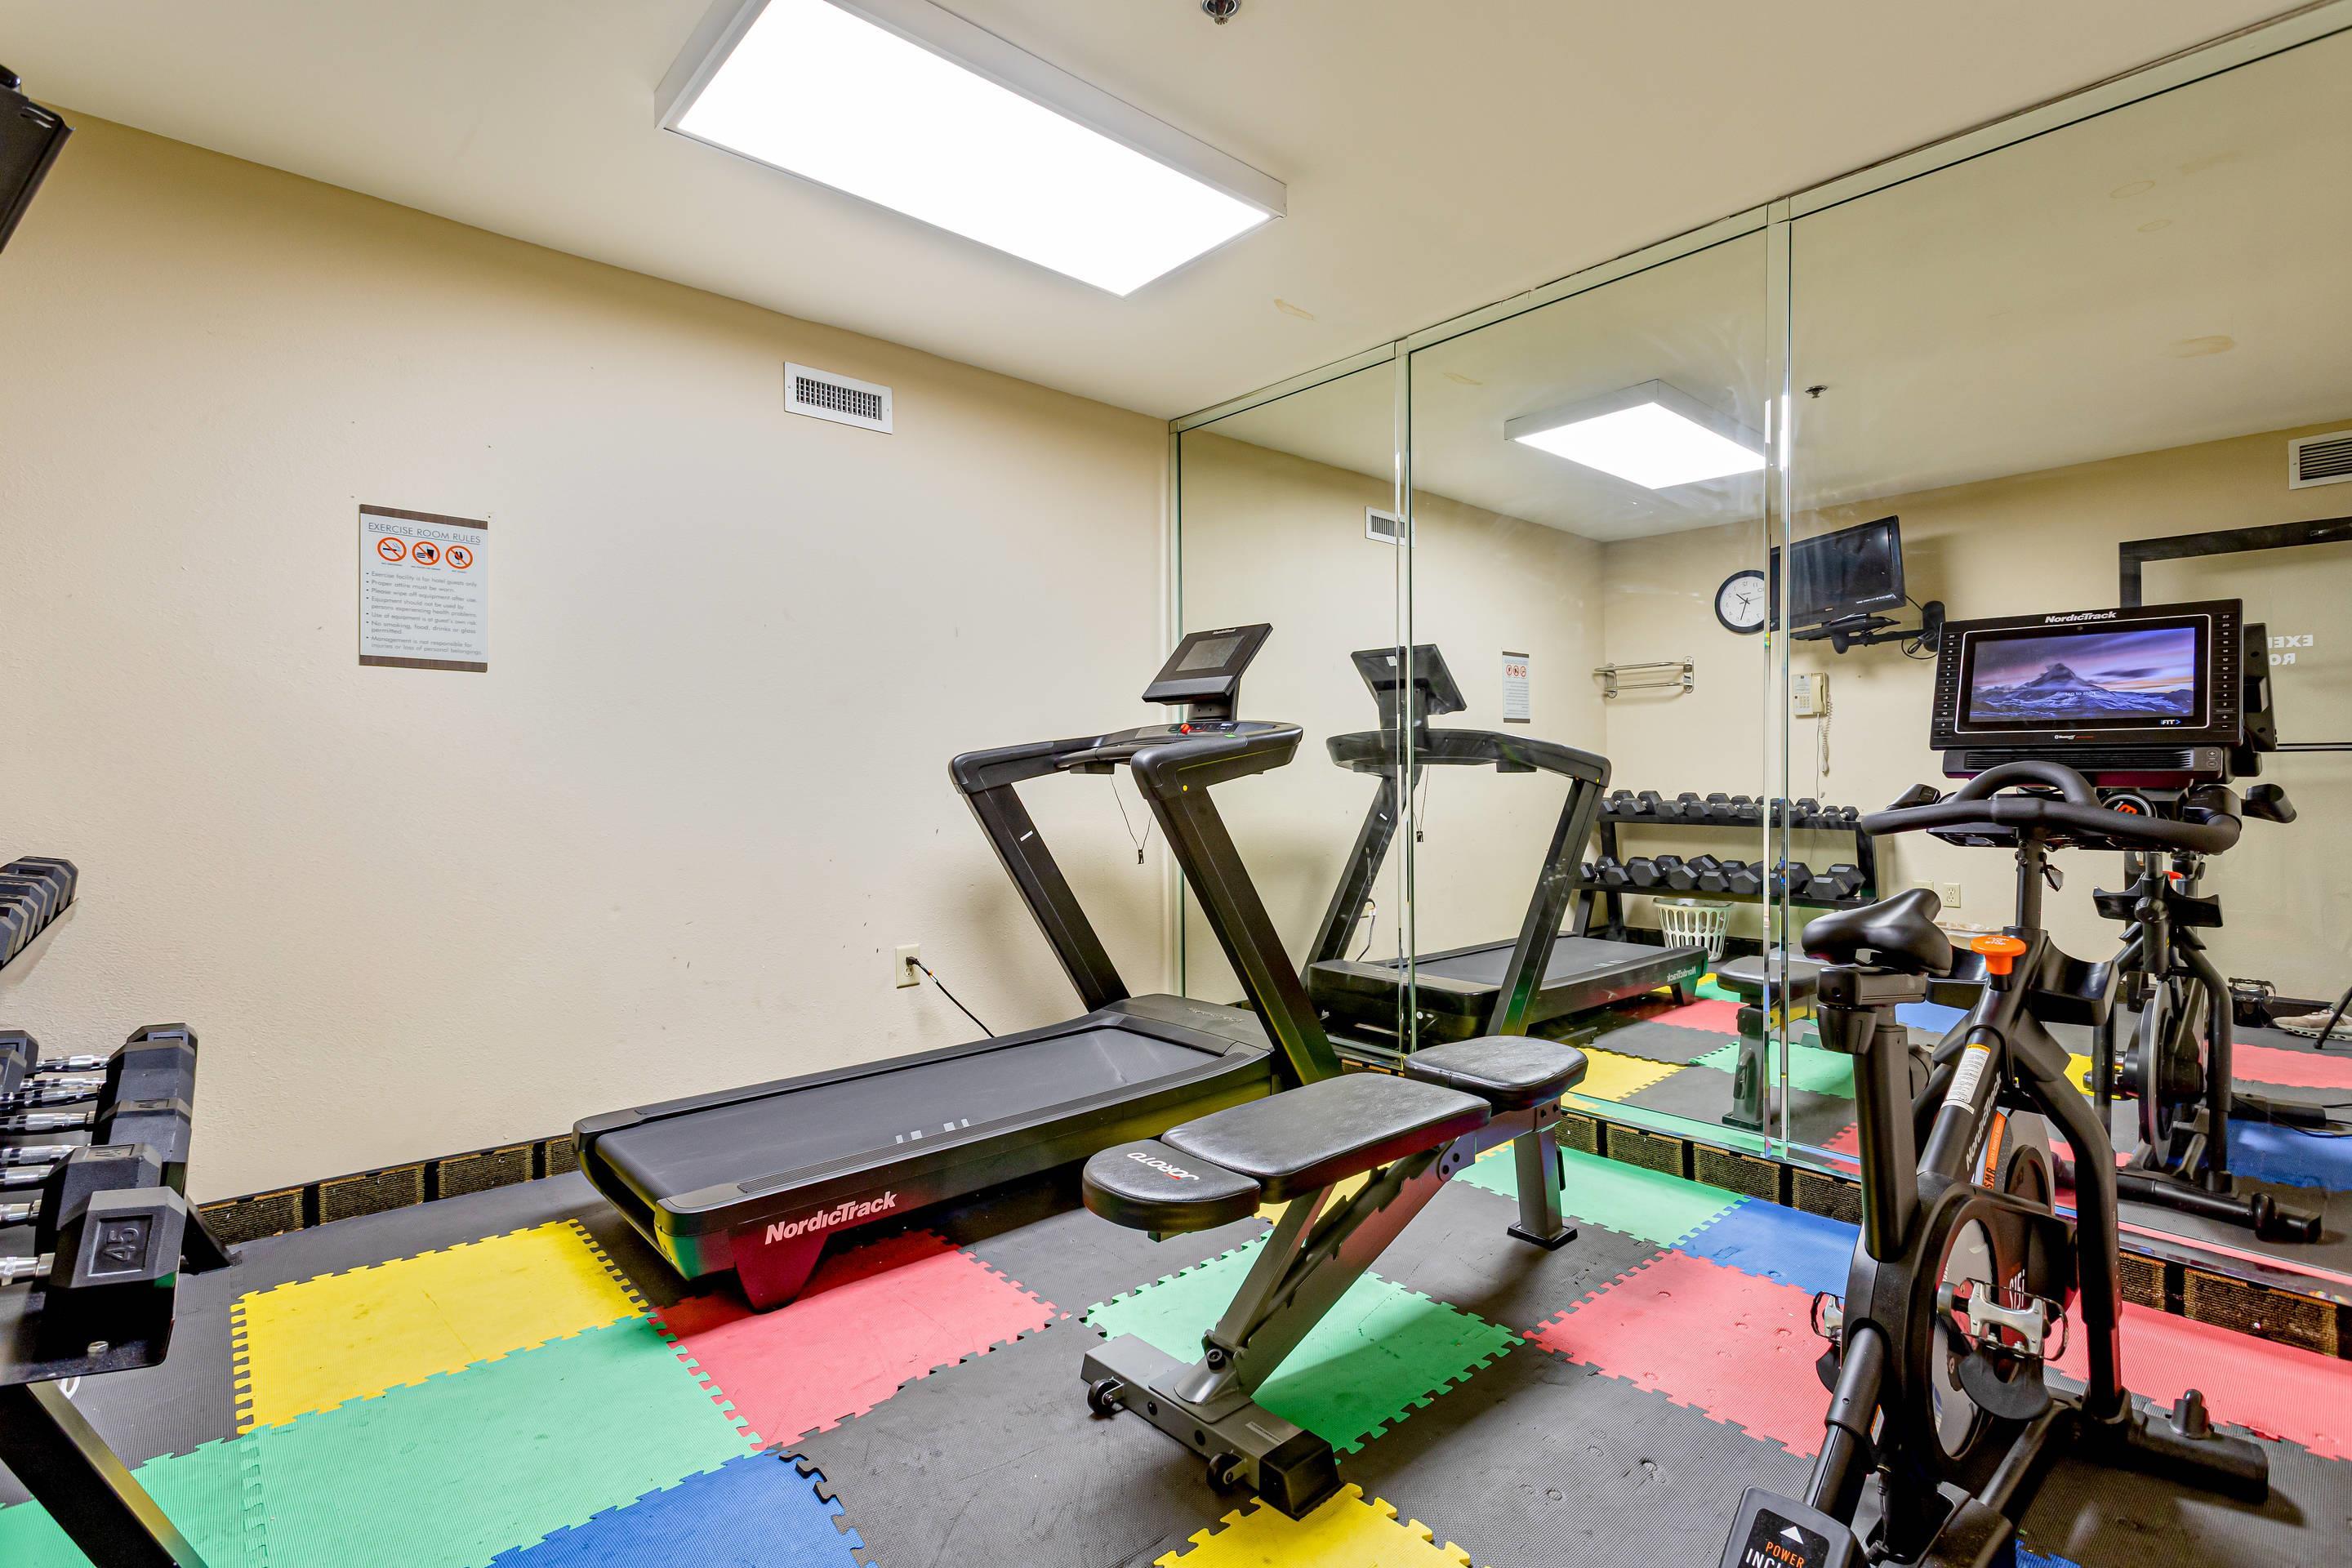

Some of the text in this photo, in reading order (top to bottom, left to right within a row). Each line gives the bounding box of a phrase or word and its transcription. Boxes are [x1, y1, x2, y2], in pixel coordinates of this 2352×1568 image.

[368, 522, 481, 543] EXERCISE ROOM RULES
[2044, 611, 2117, 623] NordicTrack
[1966, 1071, 2002, 1171] NordicTrack
[1127, 1152, 1200, 1180] JOROTO
[764, 1191, 898, 1245] NordicTrack
[104, 1227, 140, 1263] 45
[1765, 1541, 1805, 1568] POWER
